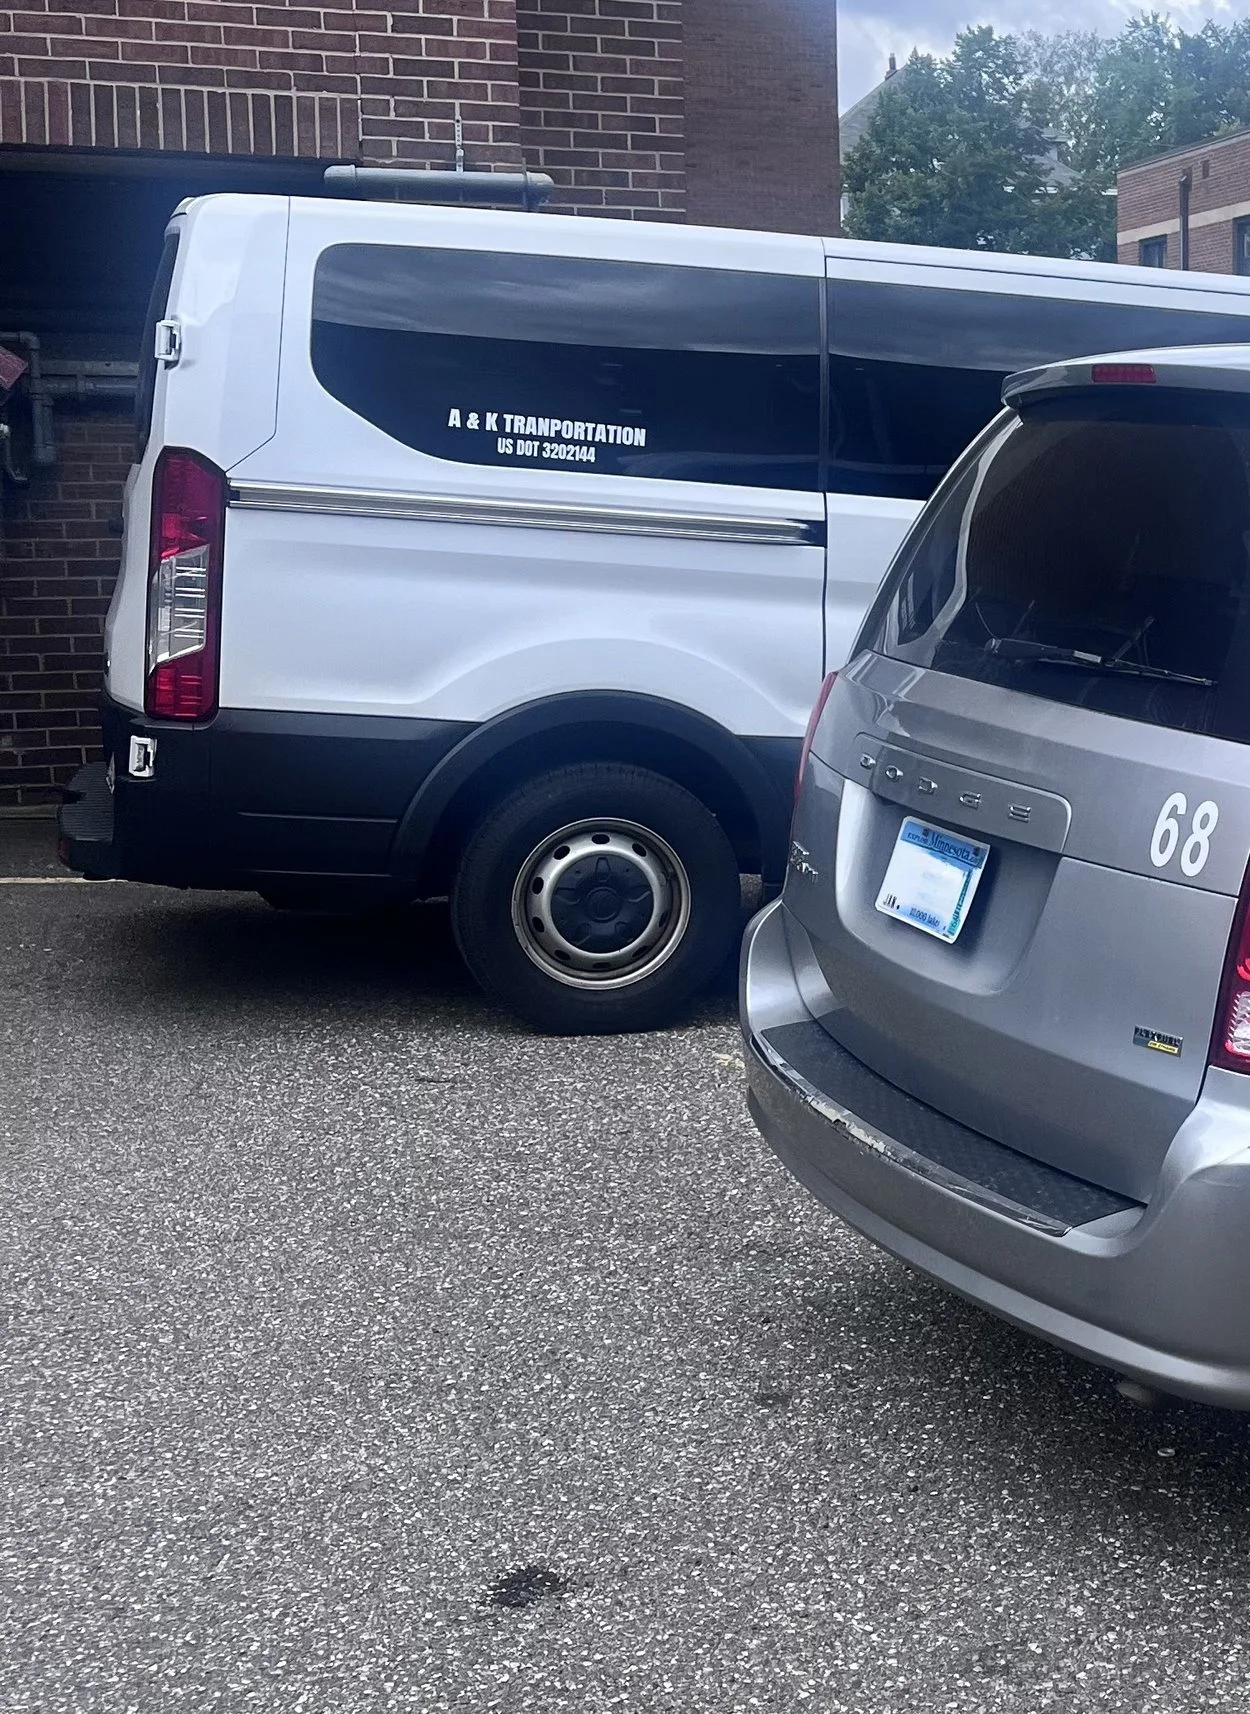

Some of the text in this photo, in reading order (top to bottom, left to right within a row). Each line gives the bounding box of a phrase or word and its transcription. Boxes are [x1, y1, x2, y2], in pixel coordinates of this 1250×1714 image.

[447, 408, 647, 447] A & K TRANPORTATION
[497, 437, 596, 463] US DOT 3202144
[860, 753, 1032, 823] DODGE
[1150, 792, 1219, 877] 68
